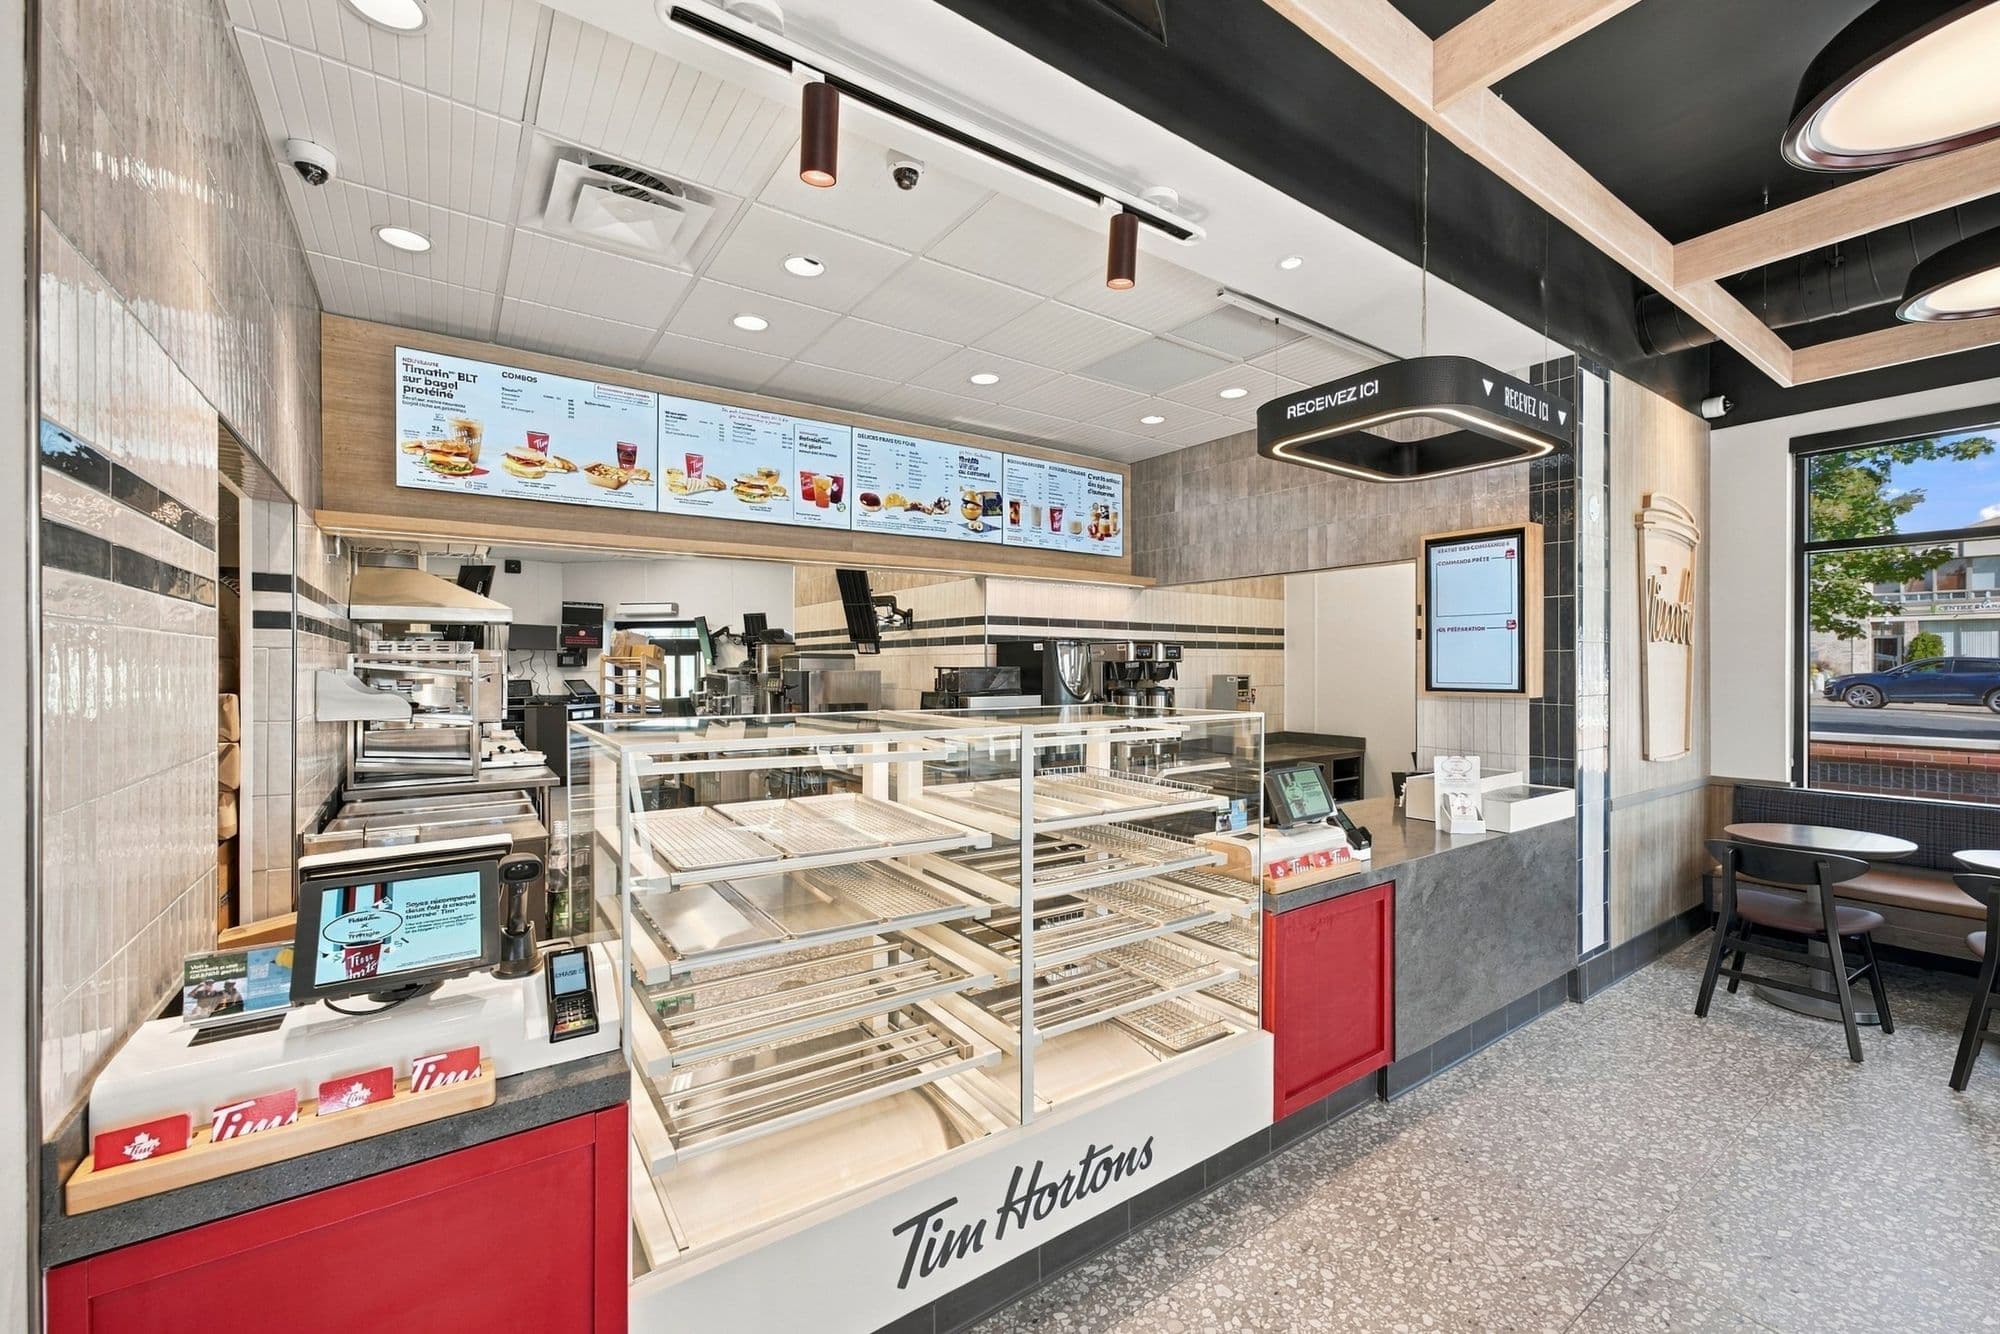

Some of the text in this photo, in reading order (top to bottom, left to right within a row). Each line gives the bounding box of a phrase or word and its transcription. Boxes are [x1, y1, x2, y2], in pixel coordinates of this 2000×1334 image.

[402, 375, 458, 390] sur bagel
[458, 372, 478, 383] BLT
[501, 371, 538, 383] COMBOS
[402, 384, 454, 399] protéiné
[1287, 380, 1379, 419] RECEIVEZ ICI
[1539, 400, 1549, 421] ICI
[892, 1135, 1154, 1290] Tim Hortons
